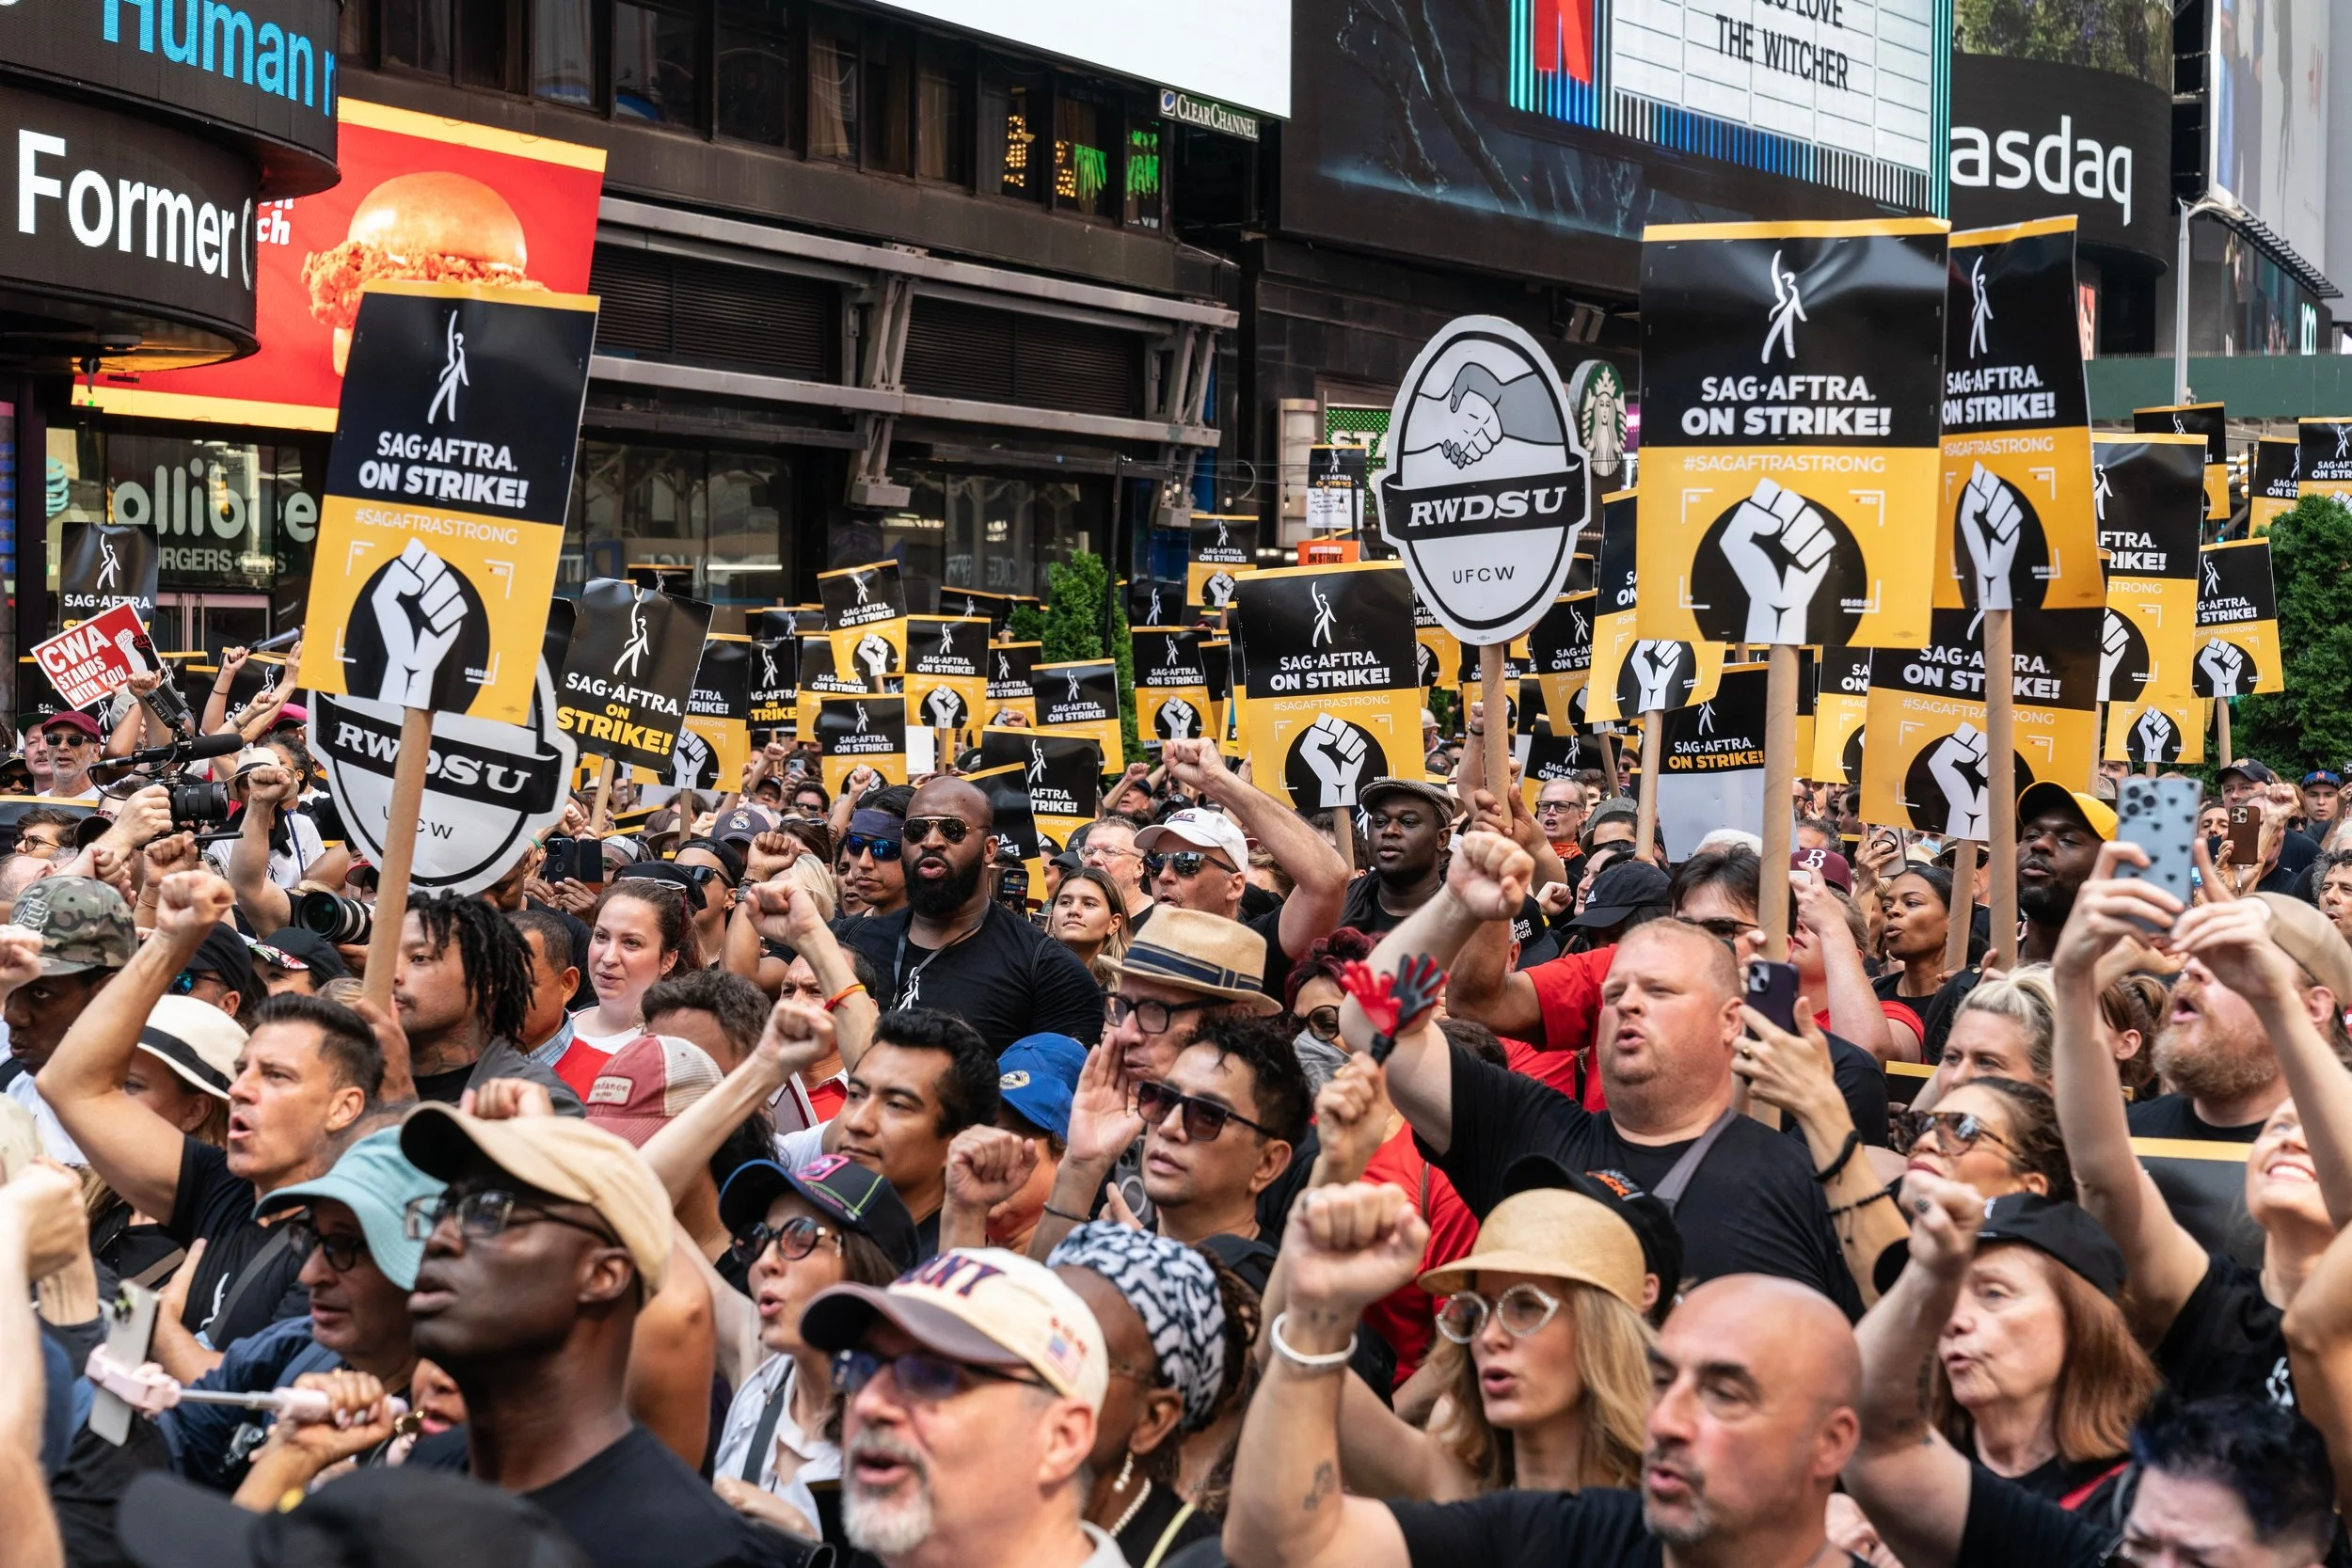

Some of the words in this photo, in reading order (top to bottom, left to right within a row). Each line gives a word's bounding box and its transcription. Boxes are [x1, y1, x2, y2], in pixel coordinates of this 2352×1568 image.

[1716, 14, 1754, 64] THE
[1763, 27, 1849, 91] WITCHER
[1949, 115, 2133, 227] asdaq
[18, 129, 235, 279] Former
[1942, 398, 1963, 426] ON
[1964, 391, 2057, 423] STRIKE!
[1681, 406, 1735, 436] ON
[1742, 405, 1893, 436] STRIKE!
[1682, 454, 1886, 473] #SAGAFTRASTRONG
[2312, 469, 2328, 480] ON
[358, 460, 401, 492] ON
[403, 466, 530, 509] STRIKE!
[2266, 486, 2283, 497] ON
[1407, 486, 1567, 528] RWDSU
[354, 507, 518, 546] #SAGAFTRASTRONG
[1453, 565, 1516, 584] UFCW
[839, 615, 856, 627] ON
[856, 608, 896, 624] STRIKE!
[2201, 607, 2258, 624] STRIKE!
[41, 625, 112, 674] CWA
[56, 656, 107, 690] STANDS
[916, 663, 936, 673] ON
[936, 664, 976, 675] STRIKE!
[1551, 659, 1572, 671] ON
[66, 678, 103, 706] WITH
[97, 663, 128, 689] YOU
[811, 682, 829, 691] ON
[1146, 676, 1165, 686] ON
[1165, 674, 1204, 686] STRIKE!
[1270, 673, 1301, 691] ON
[1306, 667, 1391, 689] STRIKE!
[1841, 676, 1868, 691] ON
[1903, 663, 1944, 688] ON
[1950, 670, 2062, 700] STKE!
[996, 687, 1034, 697] STRIKE!
[605, 704, 631, 721] ON
[1272, 694, 1391, 712] #SAGAFTRASTRONG
[1902, 696, 2056, 725] #SAGAFTRARONG
[1047, 712, 1065, 723] ON
[1065, 709, 1106, 721] STRIKE!
[557, 706, 675, 757] STRIKE!
[834, 744, 852, 753] ON
[852, 743, 894, 753] STRIKE!
[1668, 755, 1693, 770] ON
[1696, 751, 1765, 769] STRIKE!
[1032, 800, 1078, 814] TRIKE!
